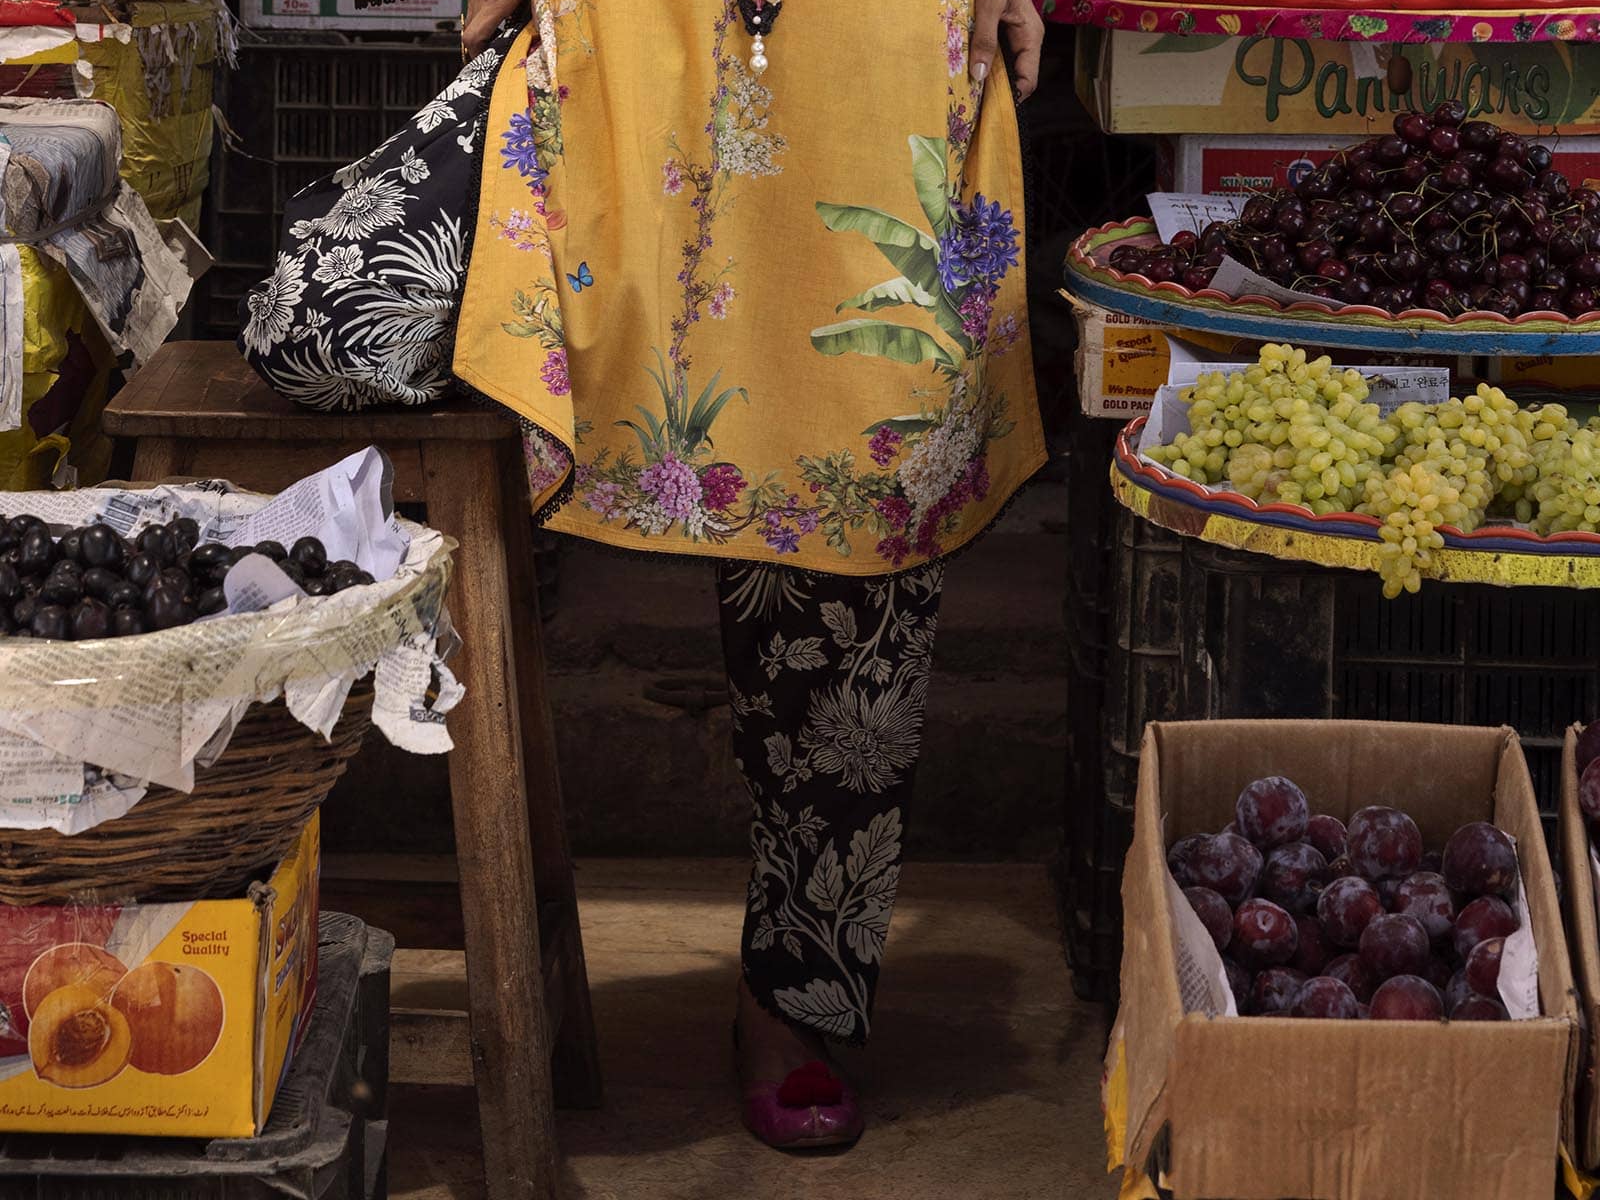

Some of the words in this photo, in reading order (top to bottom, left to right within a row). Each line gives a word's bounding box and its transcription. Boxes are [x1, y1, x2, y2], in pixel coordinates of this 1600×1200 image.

[1106, 314, 1130, 324] GOLD
[1103, 399, 1128, 409] GOLD
[182, 930, 227, 943] Special
[182, 944, 230, 957] Quality
